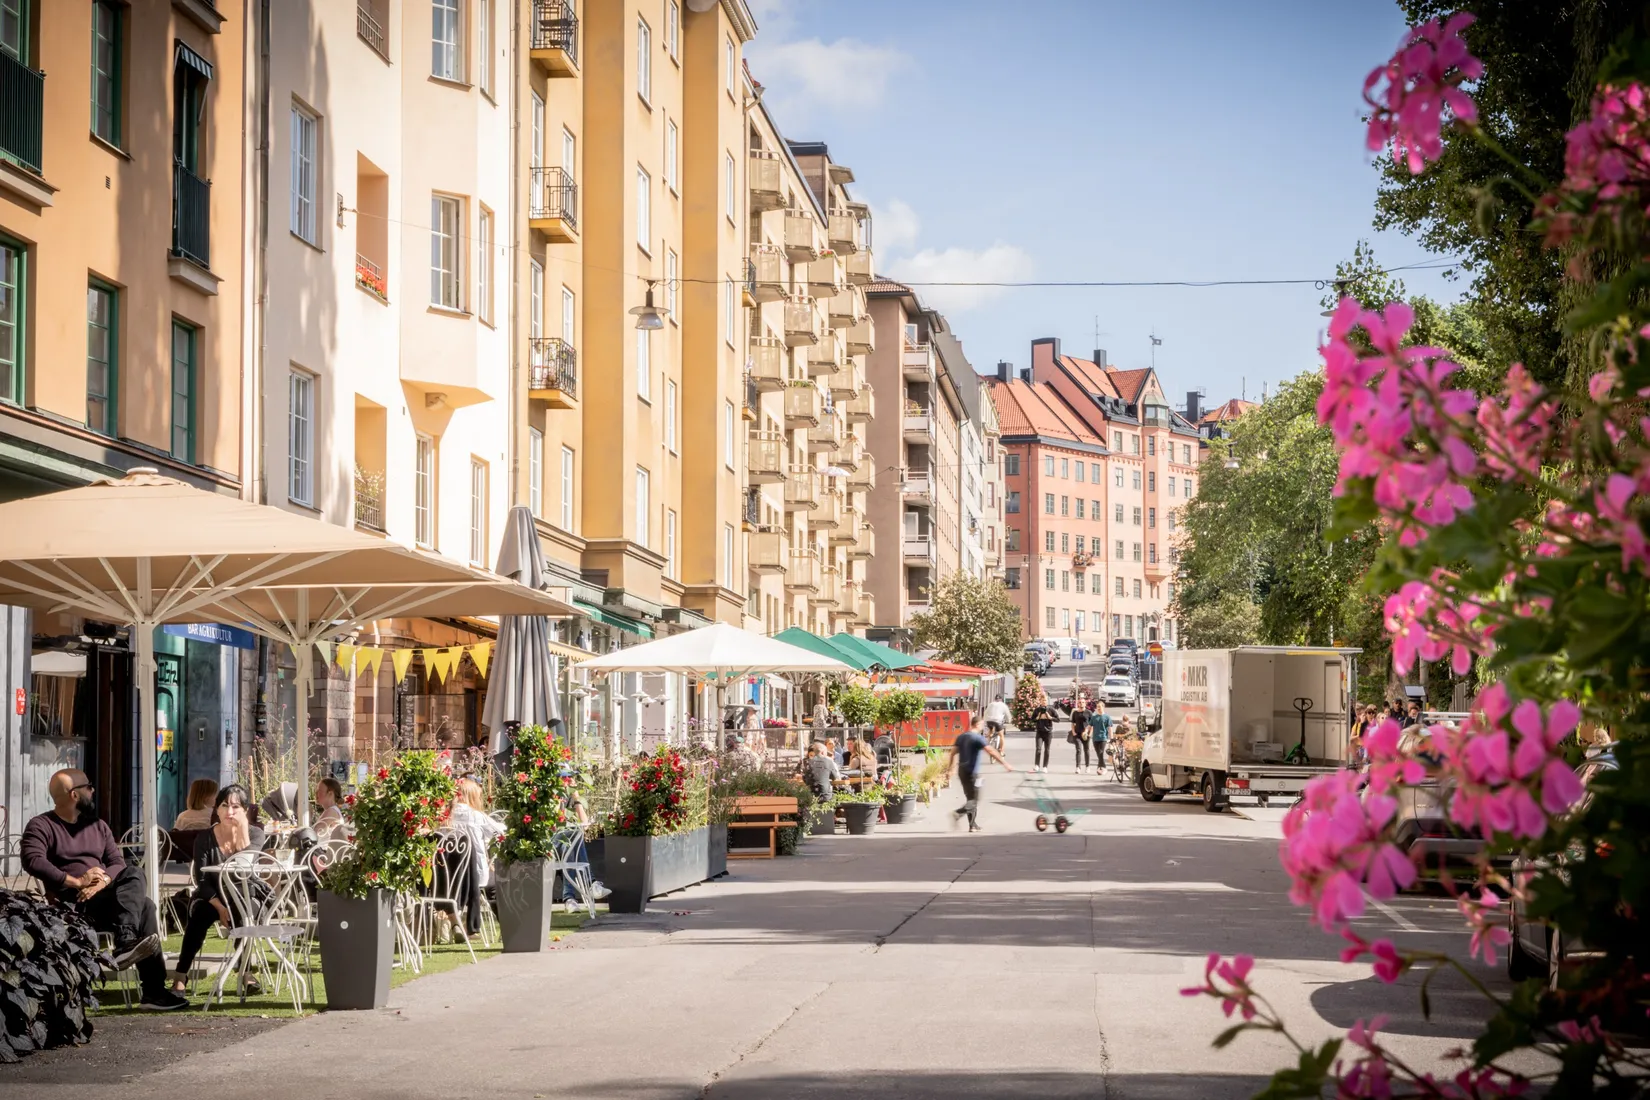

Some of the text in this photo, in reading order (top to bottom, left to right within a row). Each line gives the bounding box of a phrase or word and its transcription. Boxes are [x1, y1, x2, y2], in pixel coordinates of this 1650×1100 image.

[188, 623, 232, 642] BAR AGRIKULTUR
[1188, 666, 1207, 686] MKR
[1181, 691, 1207, 702] LOGISTIK AB
